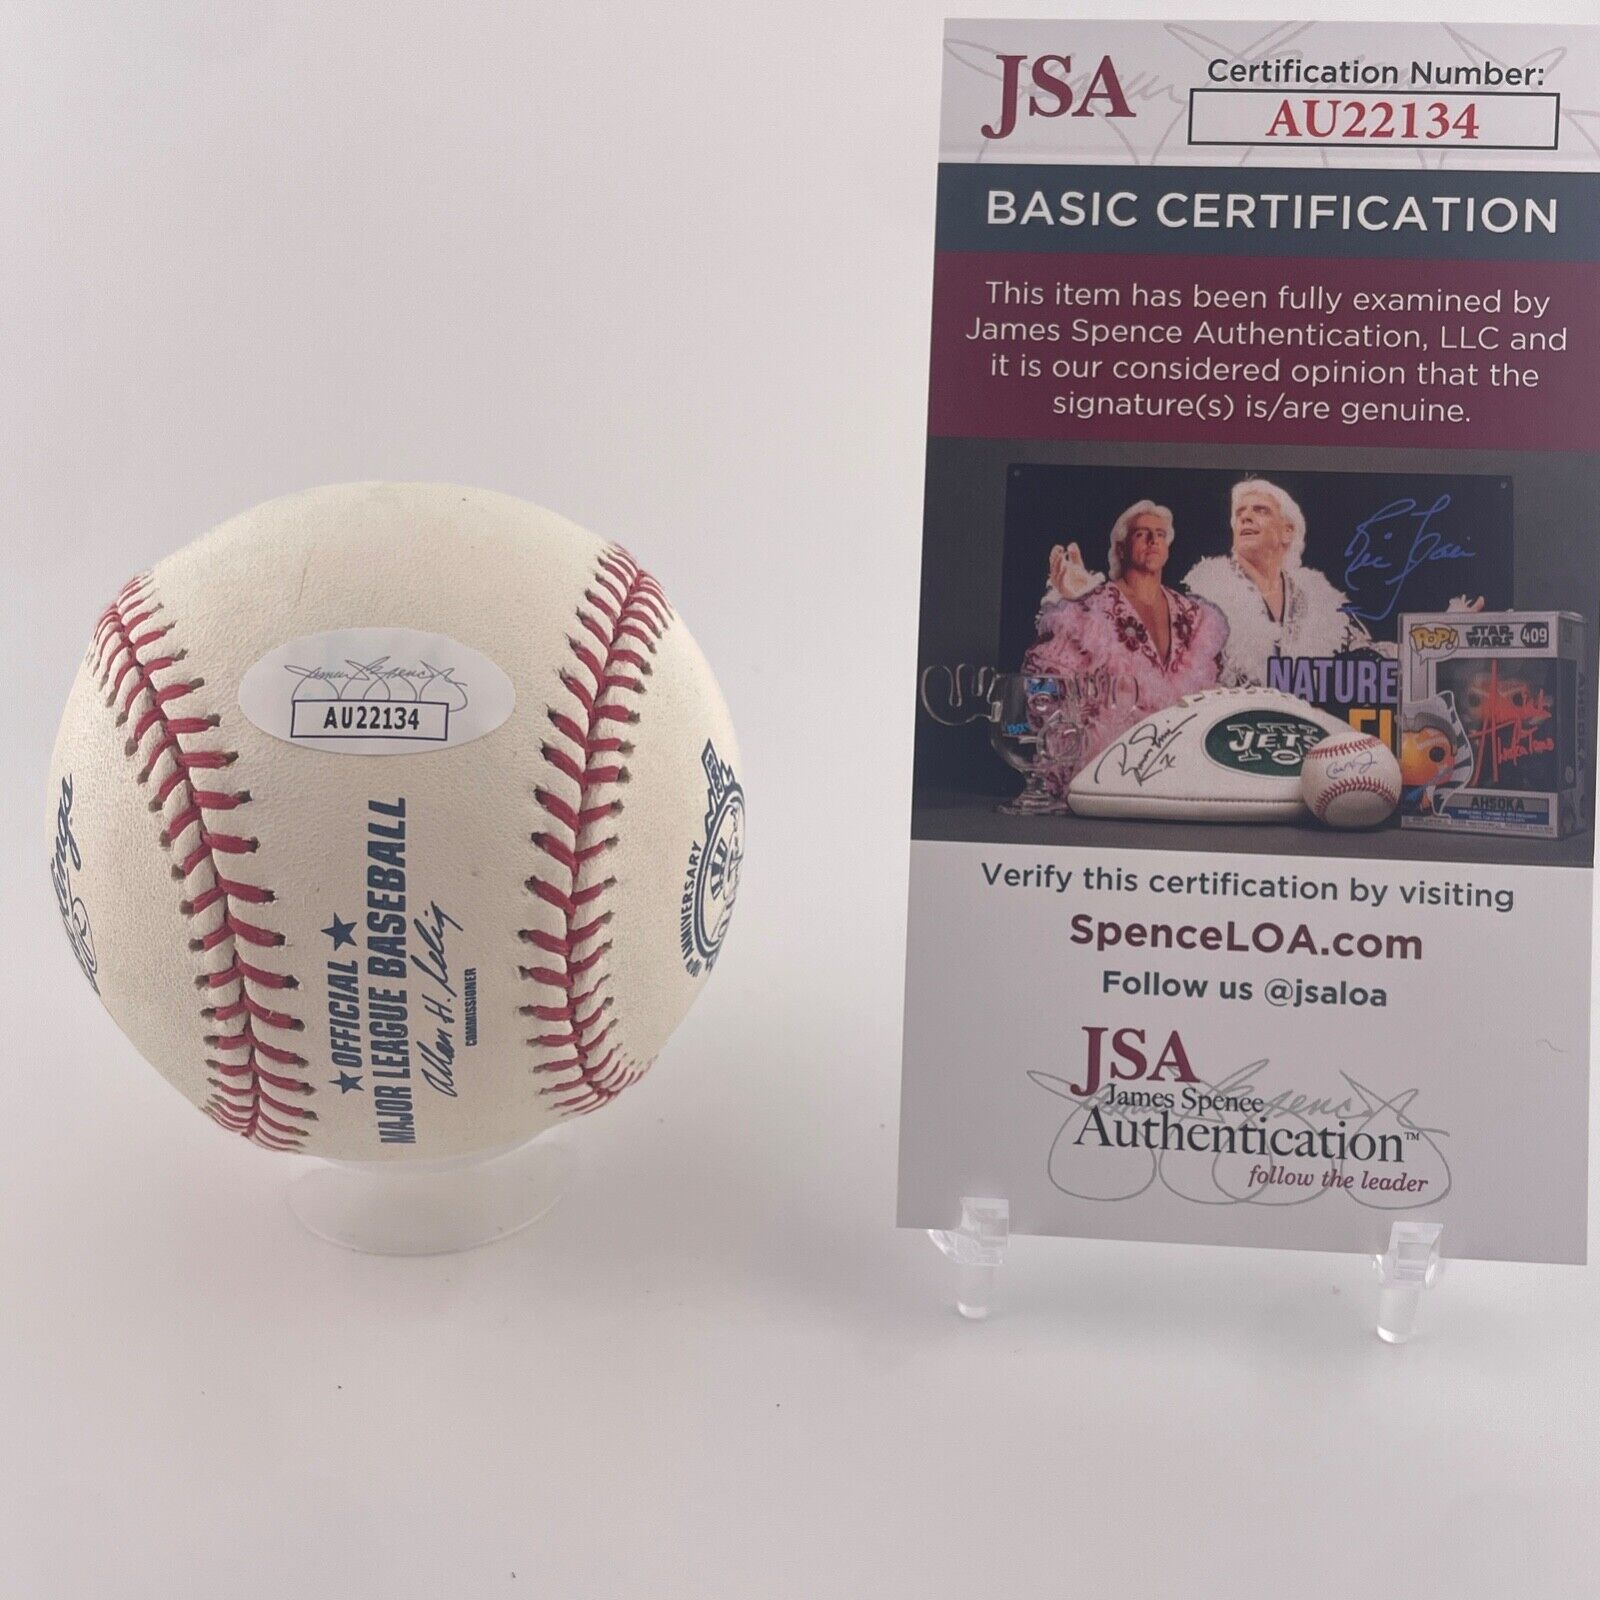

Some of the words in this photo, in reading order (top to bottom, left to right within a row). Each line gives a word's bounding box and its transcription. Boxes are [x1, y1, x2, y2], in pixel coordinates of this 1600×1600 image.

[1207, 58, 1398, 84] Certification
[1411, 61, 1544, 87] Number:
[980, 54, 1137, 140] JSA
[1264, 99, 1480, 139] AU22134
[987, 190, 1138, 227] BASIC
[1156, 192, 1557, 234] CERTIFICATION
[986, 280, 1044, 305] This
[1056, 281, 1120, 306] item
[1132, 282, 1182, 308] has
[1193, 283, 1267, 309] been
[1278, 285, 1342, 315] fully
[1353, 288, 1501, 314] examined
[1513, 290, 1551, 320] by
[965, 317, 1060, 342] James
[1071, 318, 1183, 347] Spence
[1193, 321, 1428, 351] Authentication,
[1441, 325, 1499, 351] LLC
[1510, 327, 1567, 352] and
[991, 353, 1010, 377] it
[1020, 353, 1042, 378] is
[1052, 359, 1103, 379] our
[1112, 356, 1280, 382] considered
[1291, 359, 1405, 388] opinion
[1417, 361, 1479, 386] that
[1489, 362, 1539, 388] the
[1053, 391, 1234, 421] signature(s)
[1246, 392, 1330, 422] is/are
[1341, 398, 1470, 426] genuine.
[1466, 625, 1514, 637] STAR
[1466, 635, 1514, 647] WARS
[1521, 627, 1548, 644] 409
[1268, 656, 1398, 704] NATURE
[323, 706, 420, 731] AU22134
[366, 797, 408, 979] BASEBALL
[680, 840, 702, 961] ANNIVERSARY
[981, 862, 1073, 893] Verify
[1082, 866, 1138, 892] this
[1149, 869, 1338, 902] certification
[1350, 877, 1388, 908] by
[1399, 880, 1514, 913] visiting
[1069, 913, 1423, 960] SpenceLOA.com
[463, 967, 478, 1047] COMMISSIONER
[1103, 970, 1209, 998] Follow
[1219, 979, 1253, 1001] us
[1264, 976, 1387, 1008] @jsaloa
[327, 960, 363, 1069] OFFICIAL
[367, 986, 412, 1080] LEAGUE
[1069, 1026, 1201, 1097] JSA
[373, 1085, 417, 1144] MAJOR
[1104, 1083, 1174, 1109] James
[1181, 1087, 1265, 1117] Spence
[1073, 1104, 1406, 1164] Authentication
[1248, 1164, 1315, 1189] follow
[1321, 1169, 1355, 1189] the
[1361, 1171, 1430, 1193] leader
